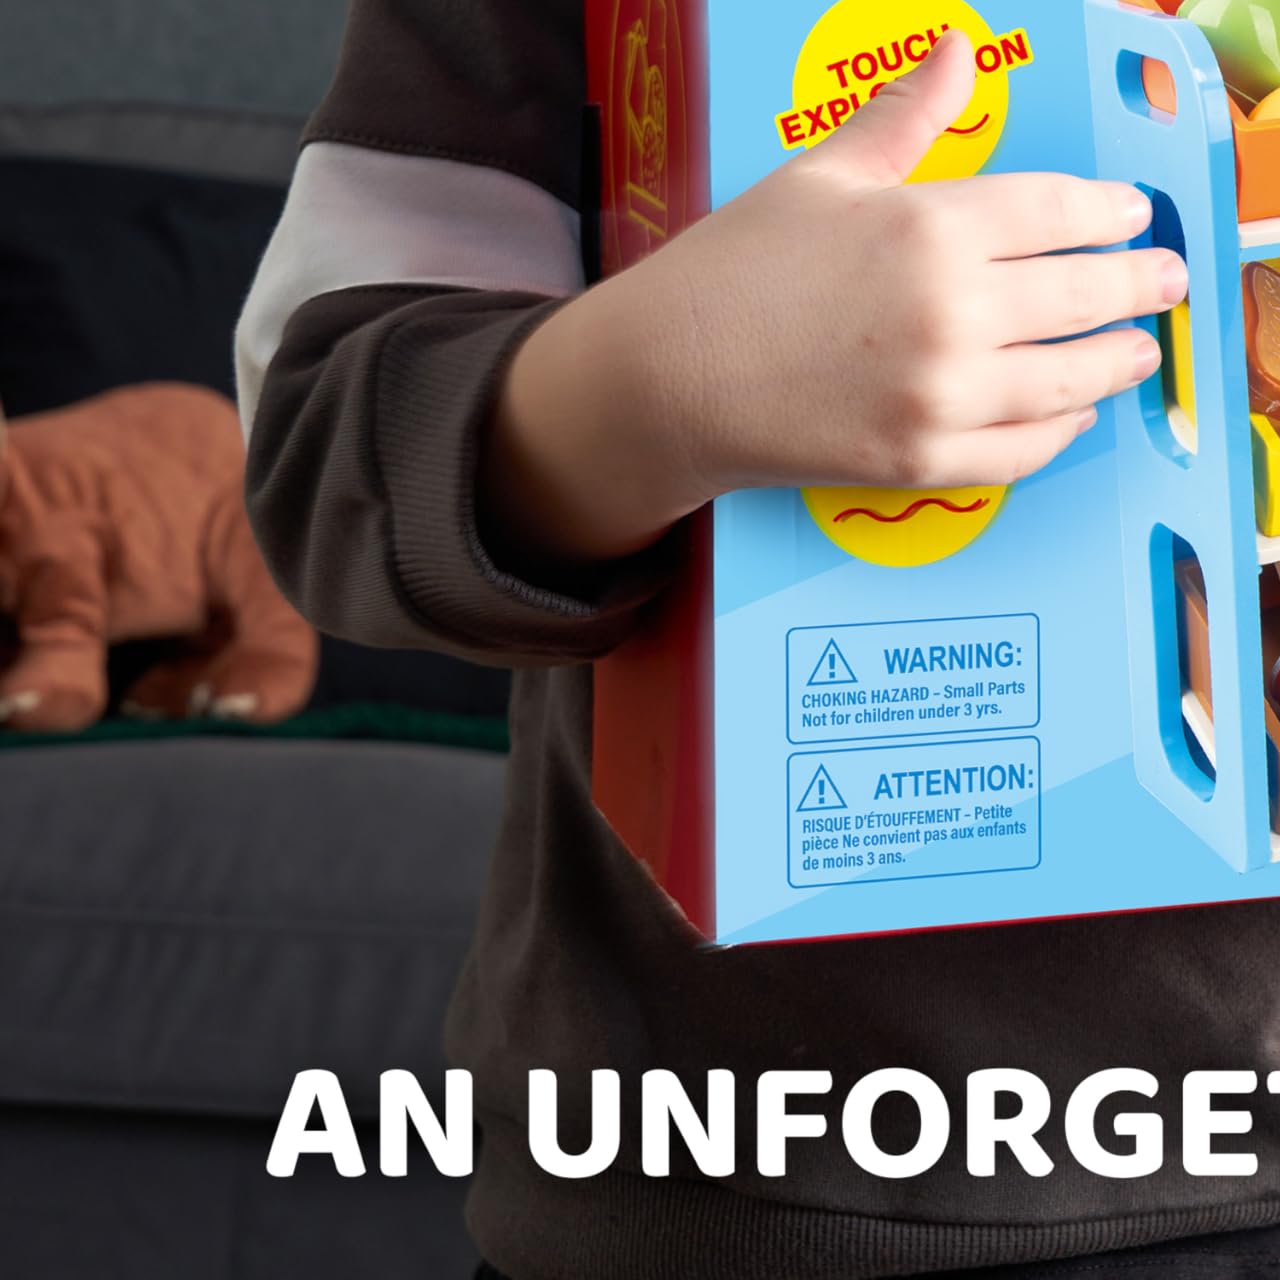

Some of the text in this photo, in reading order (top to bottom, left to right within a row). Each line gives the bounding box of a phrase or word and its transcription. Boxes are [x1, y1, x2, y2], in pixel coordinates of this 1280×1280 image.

[884, 641, 1022, 675] WARNING:
[801, 690, 867, 709] CHOKING
[871, 686, 930, 704] HAZARD
[943, 682, 984, 699] Small
[988, 680, 1025, 696] Parts
[802, 702, 1002, 728] Not for children under 3 yrs.
[873, 763, 1034, 801] ATTENTION:
[802, 816, 852, 834] RISQUE
[974, 804, 1013, 820] Petite
[802, 820, 1027, 854] pièce Ne convient pas aux enfants
[802, 851, 907, 871] de moins 3 ans.
